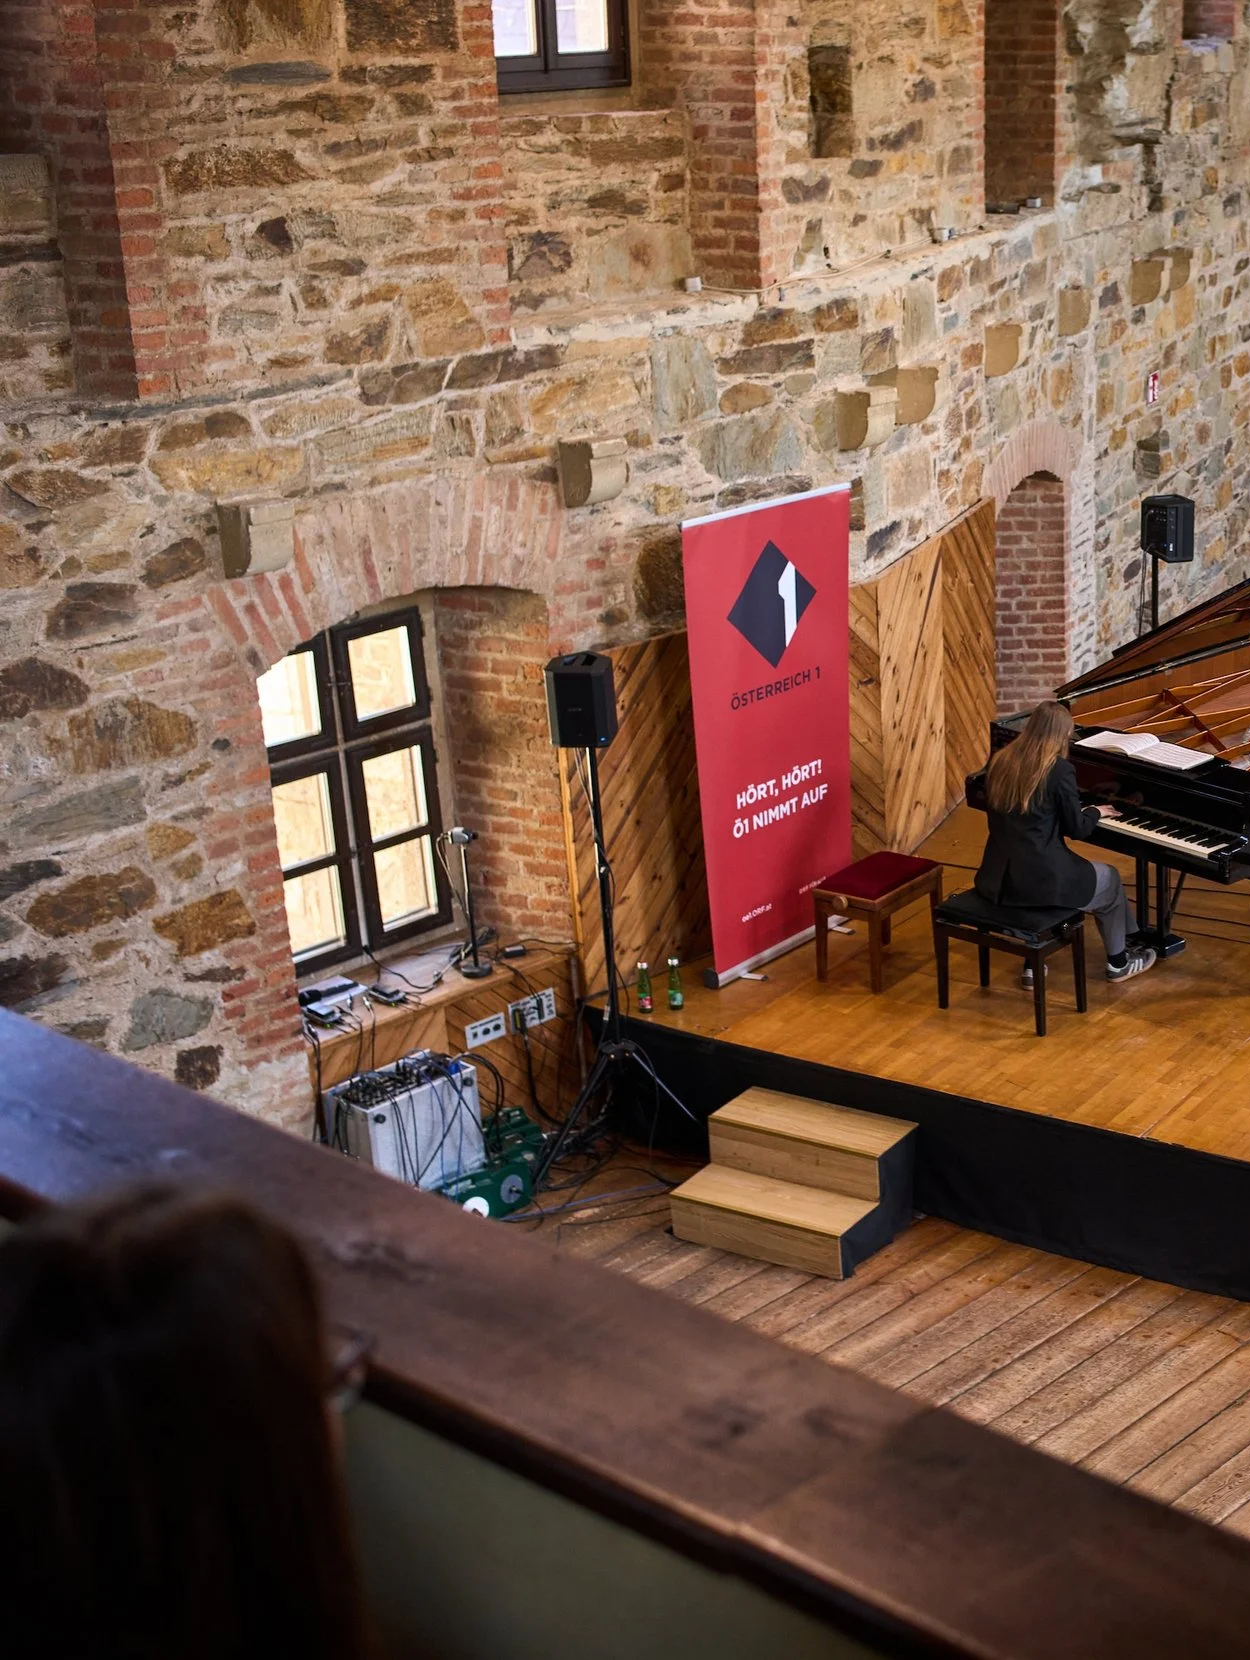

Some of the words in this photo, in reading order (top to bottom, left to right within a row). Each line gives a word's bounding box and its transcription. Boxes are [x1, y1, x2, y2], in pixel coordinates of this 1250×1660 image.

[778, 560, 798, 648] 1
[730, 669, 811, 711] ÖSTERREICH
[815, 665, 821, 680] 1
[732, 817, 750, 839] Ö1
[752, 796, 799, 831] NIMMT
[801, 783, 829, 809] AUF
[736, 778, 779, 810] HÖRT,
[781, 758, 823, 791] HÖRT!
